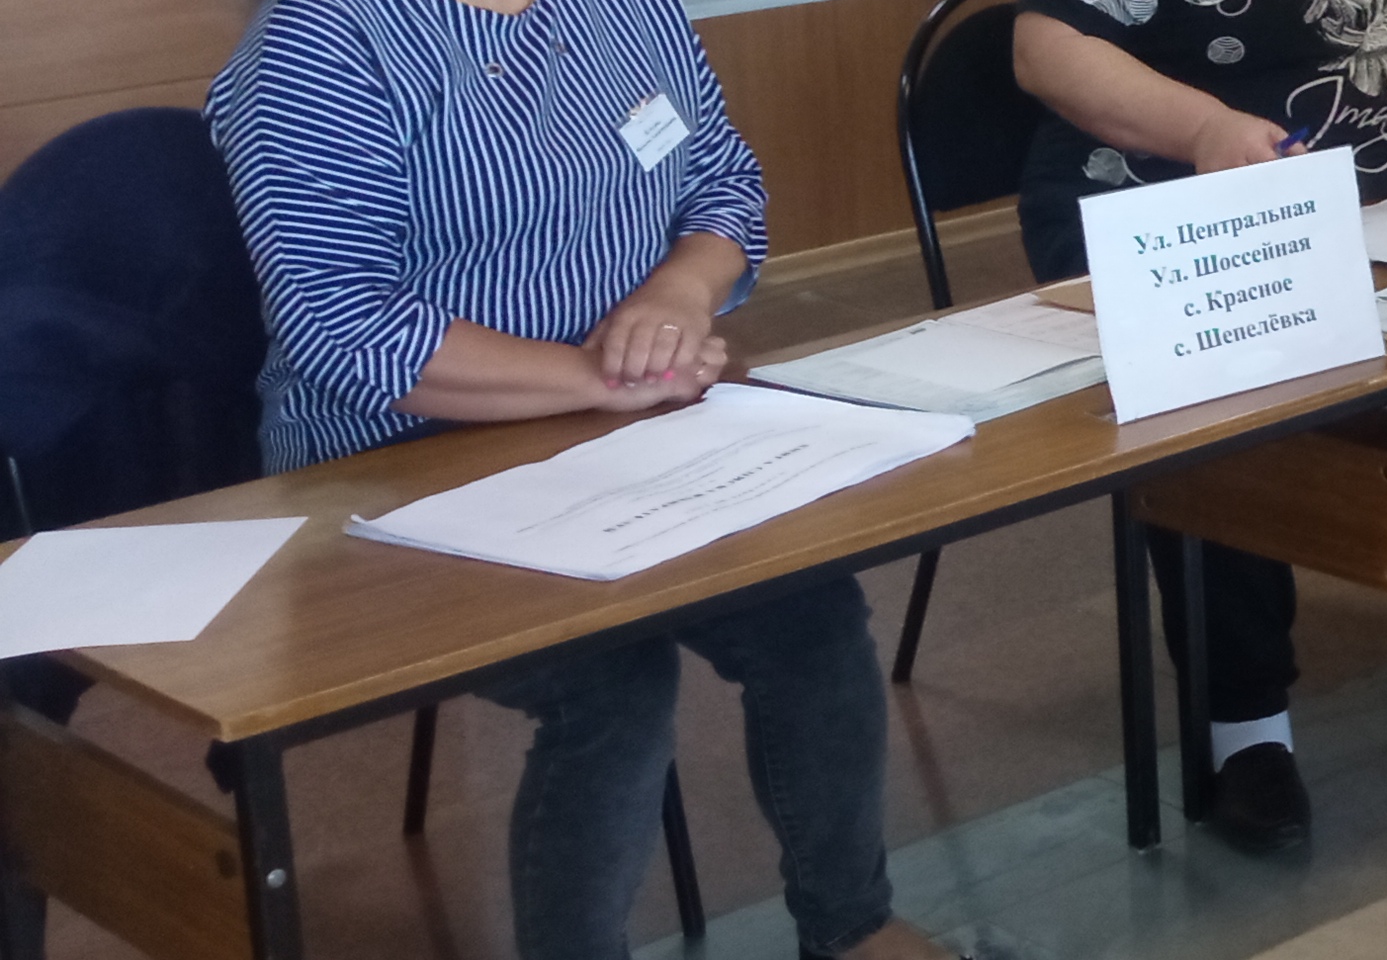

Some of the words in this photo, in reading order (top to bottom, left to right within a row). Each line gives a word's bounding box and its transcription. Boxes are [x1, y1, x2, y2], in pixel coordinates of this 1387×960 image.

[1133, 232, 1172, 255] Ул.
[1177, 199, 1317, 244] Центральная
[1150, 266, 1188, 288] Ул.
[1194, 237, 1312, 277] Шоссейная
[1184, 302, 1201, 317] с.
[1205, 277, 1294, 312] Красное
[1174, 342, 1191, 357] с.
[1196, 307, 1317, 351] Шепелёвка
